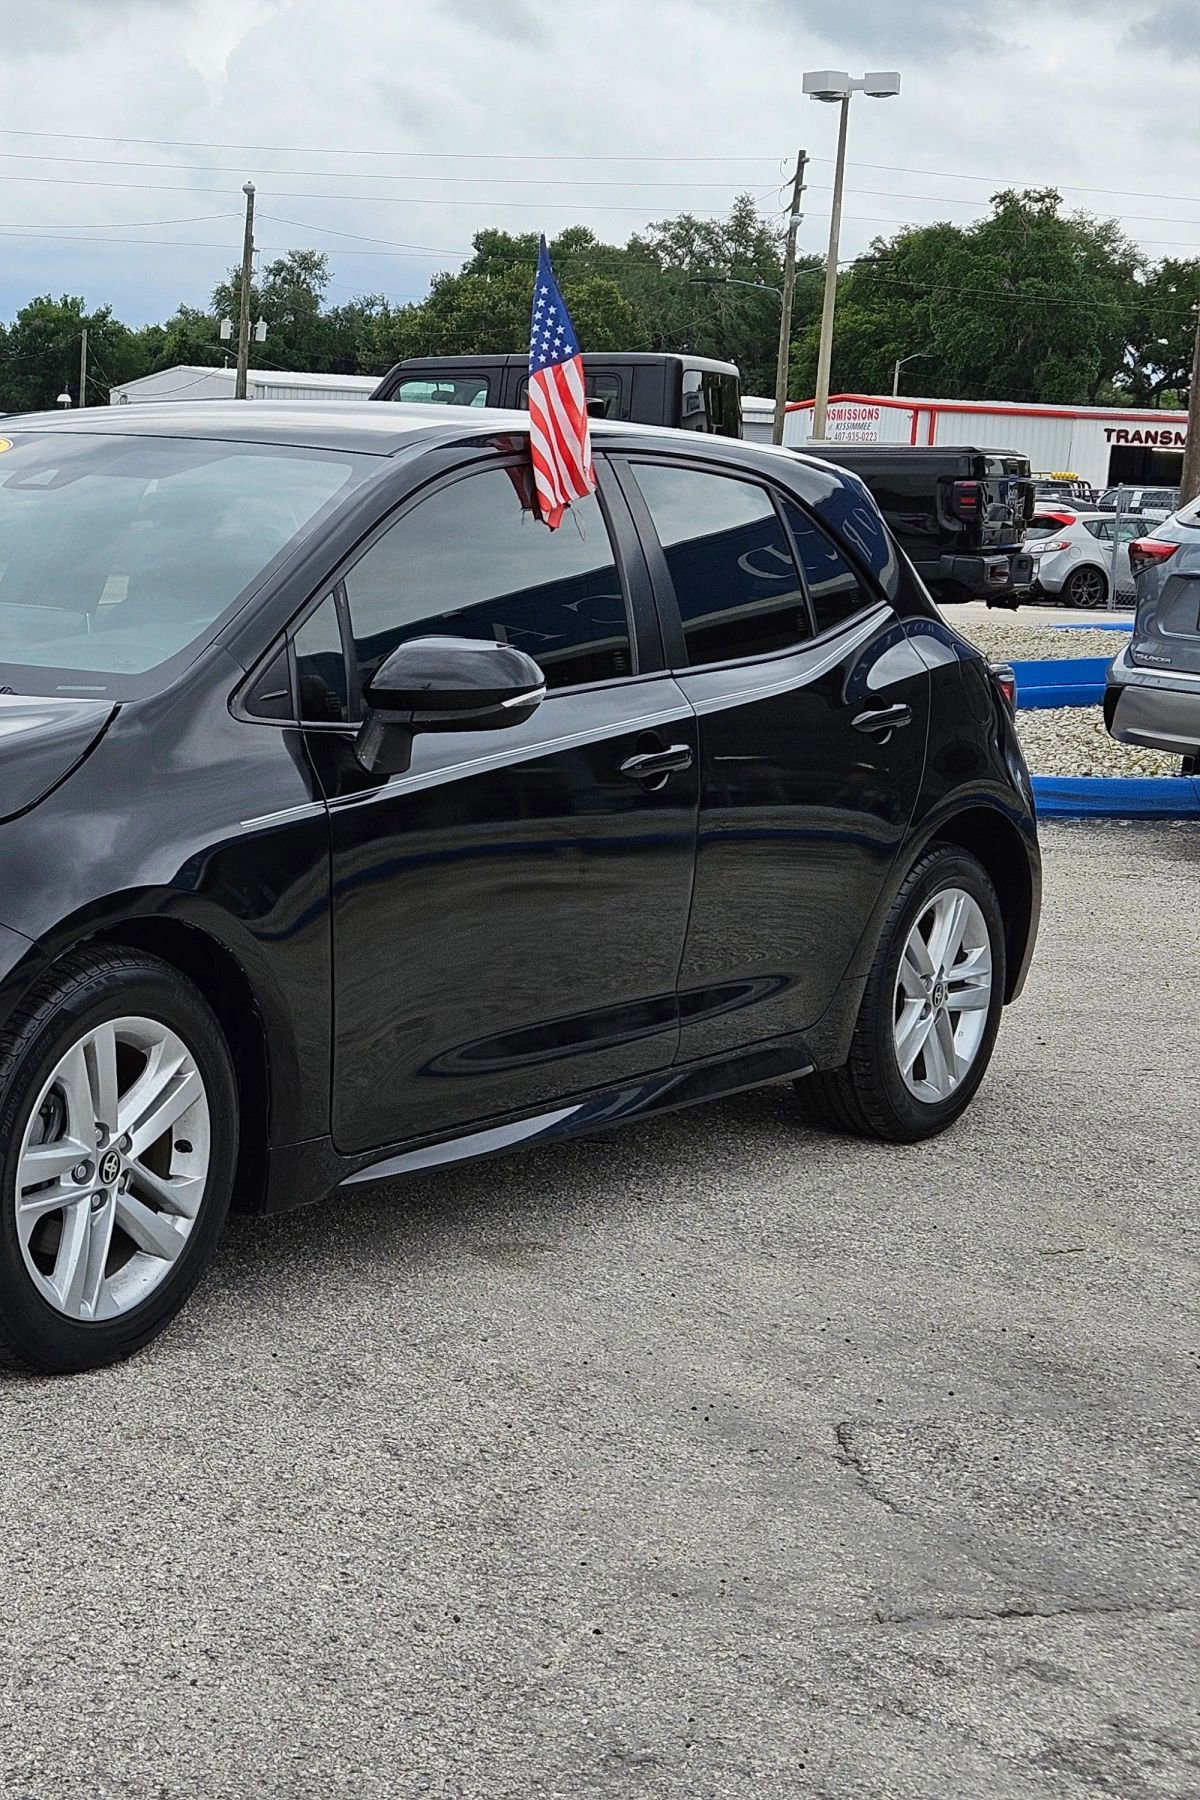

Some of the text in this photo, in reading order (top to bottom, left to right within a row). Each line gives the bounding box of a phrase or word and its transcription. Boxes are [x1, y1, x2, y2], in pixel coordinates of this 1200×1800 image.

[809, 407, 880, 421] TNSMISSIONS
[835, 421, 873, 431] KISSIMMEE
[834, 431, 878, 442] 407-935-0223
